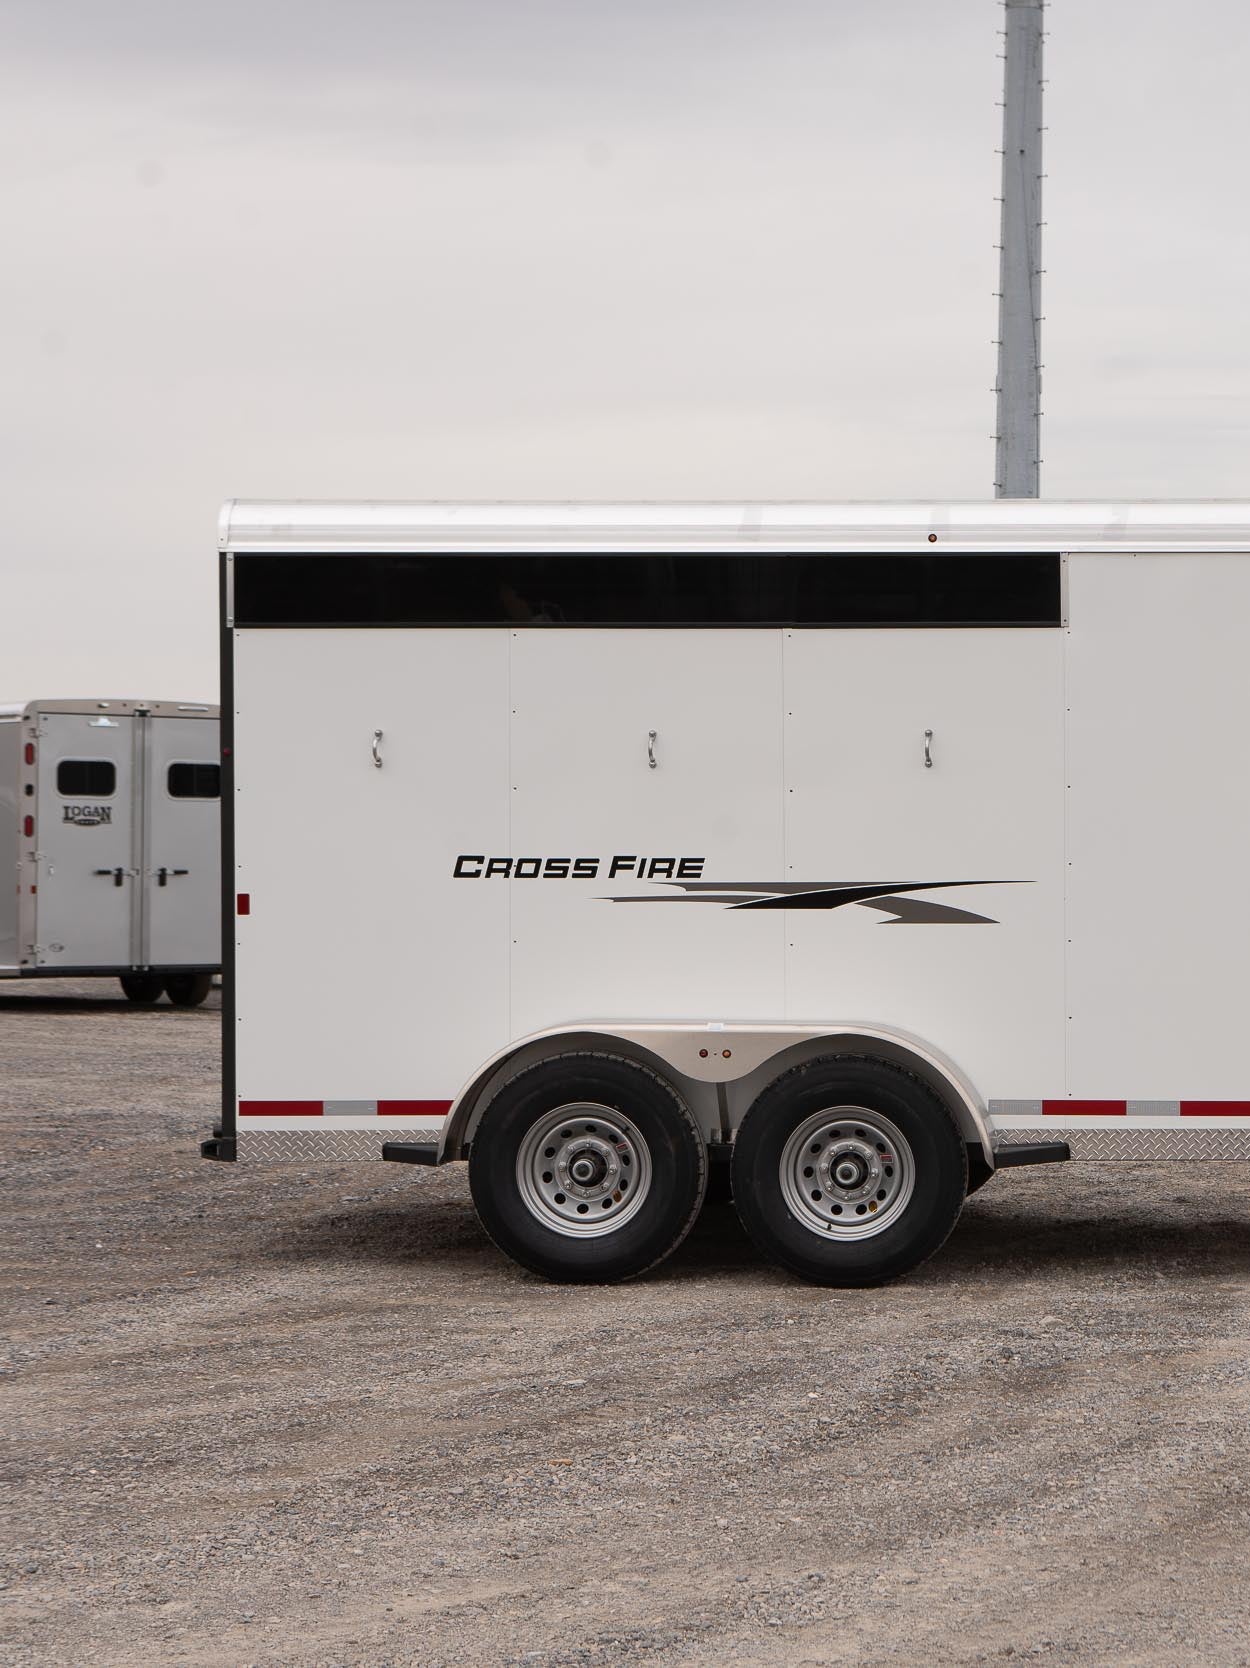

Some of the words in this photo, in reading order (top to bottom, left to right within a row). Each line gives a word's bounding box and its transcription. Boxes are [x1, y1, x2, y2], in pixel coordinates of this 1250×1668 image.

[62, 805, 112, 821] LOGAN
[453, 855, 600, 879] CROSS
[608, 855, 705, 879] FIRE
